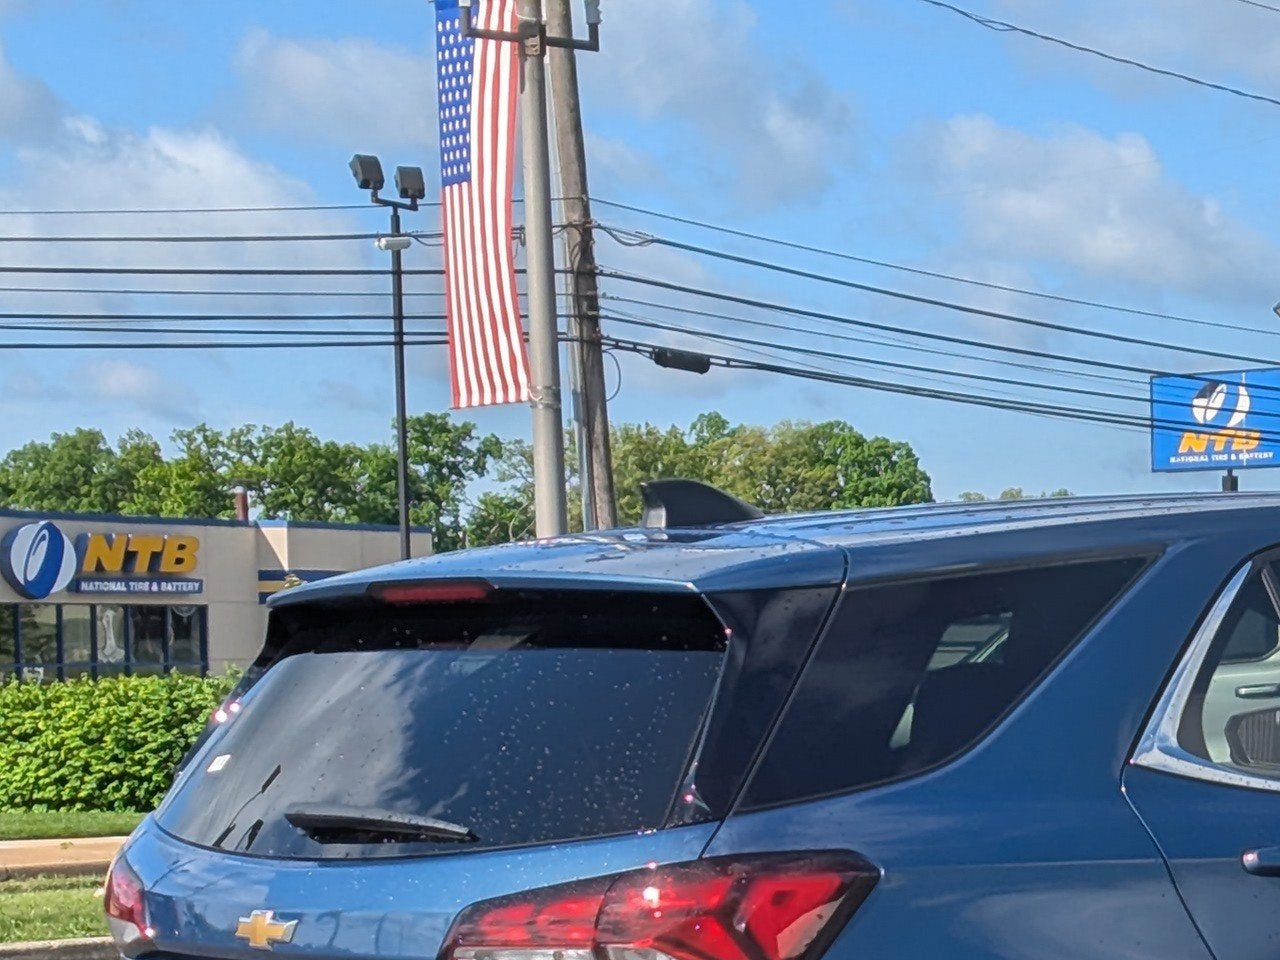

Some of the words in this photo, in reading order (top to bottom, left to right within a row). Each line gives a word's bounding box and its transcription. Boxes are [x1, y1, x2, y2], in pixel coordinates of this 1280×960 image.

[1178, 429, 1261, 454] NTB
[82, 533, 200, 574] NTB
[81, 581, 127, 592] NATIONAL
[129, 581, 149, 592] TIRE
[151, 582, 159, 592] &
[161, 581, 200, 592] BATTERY
